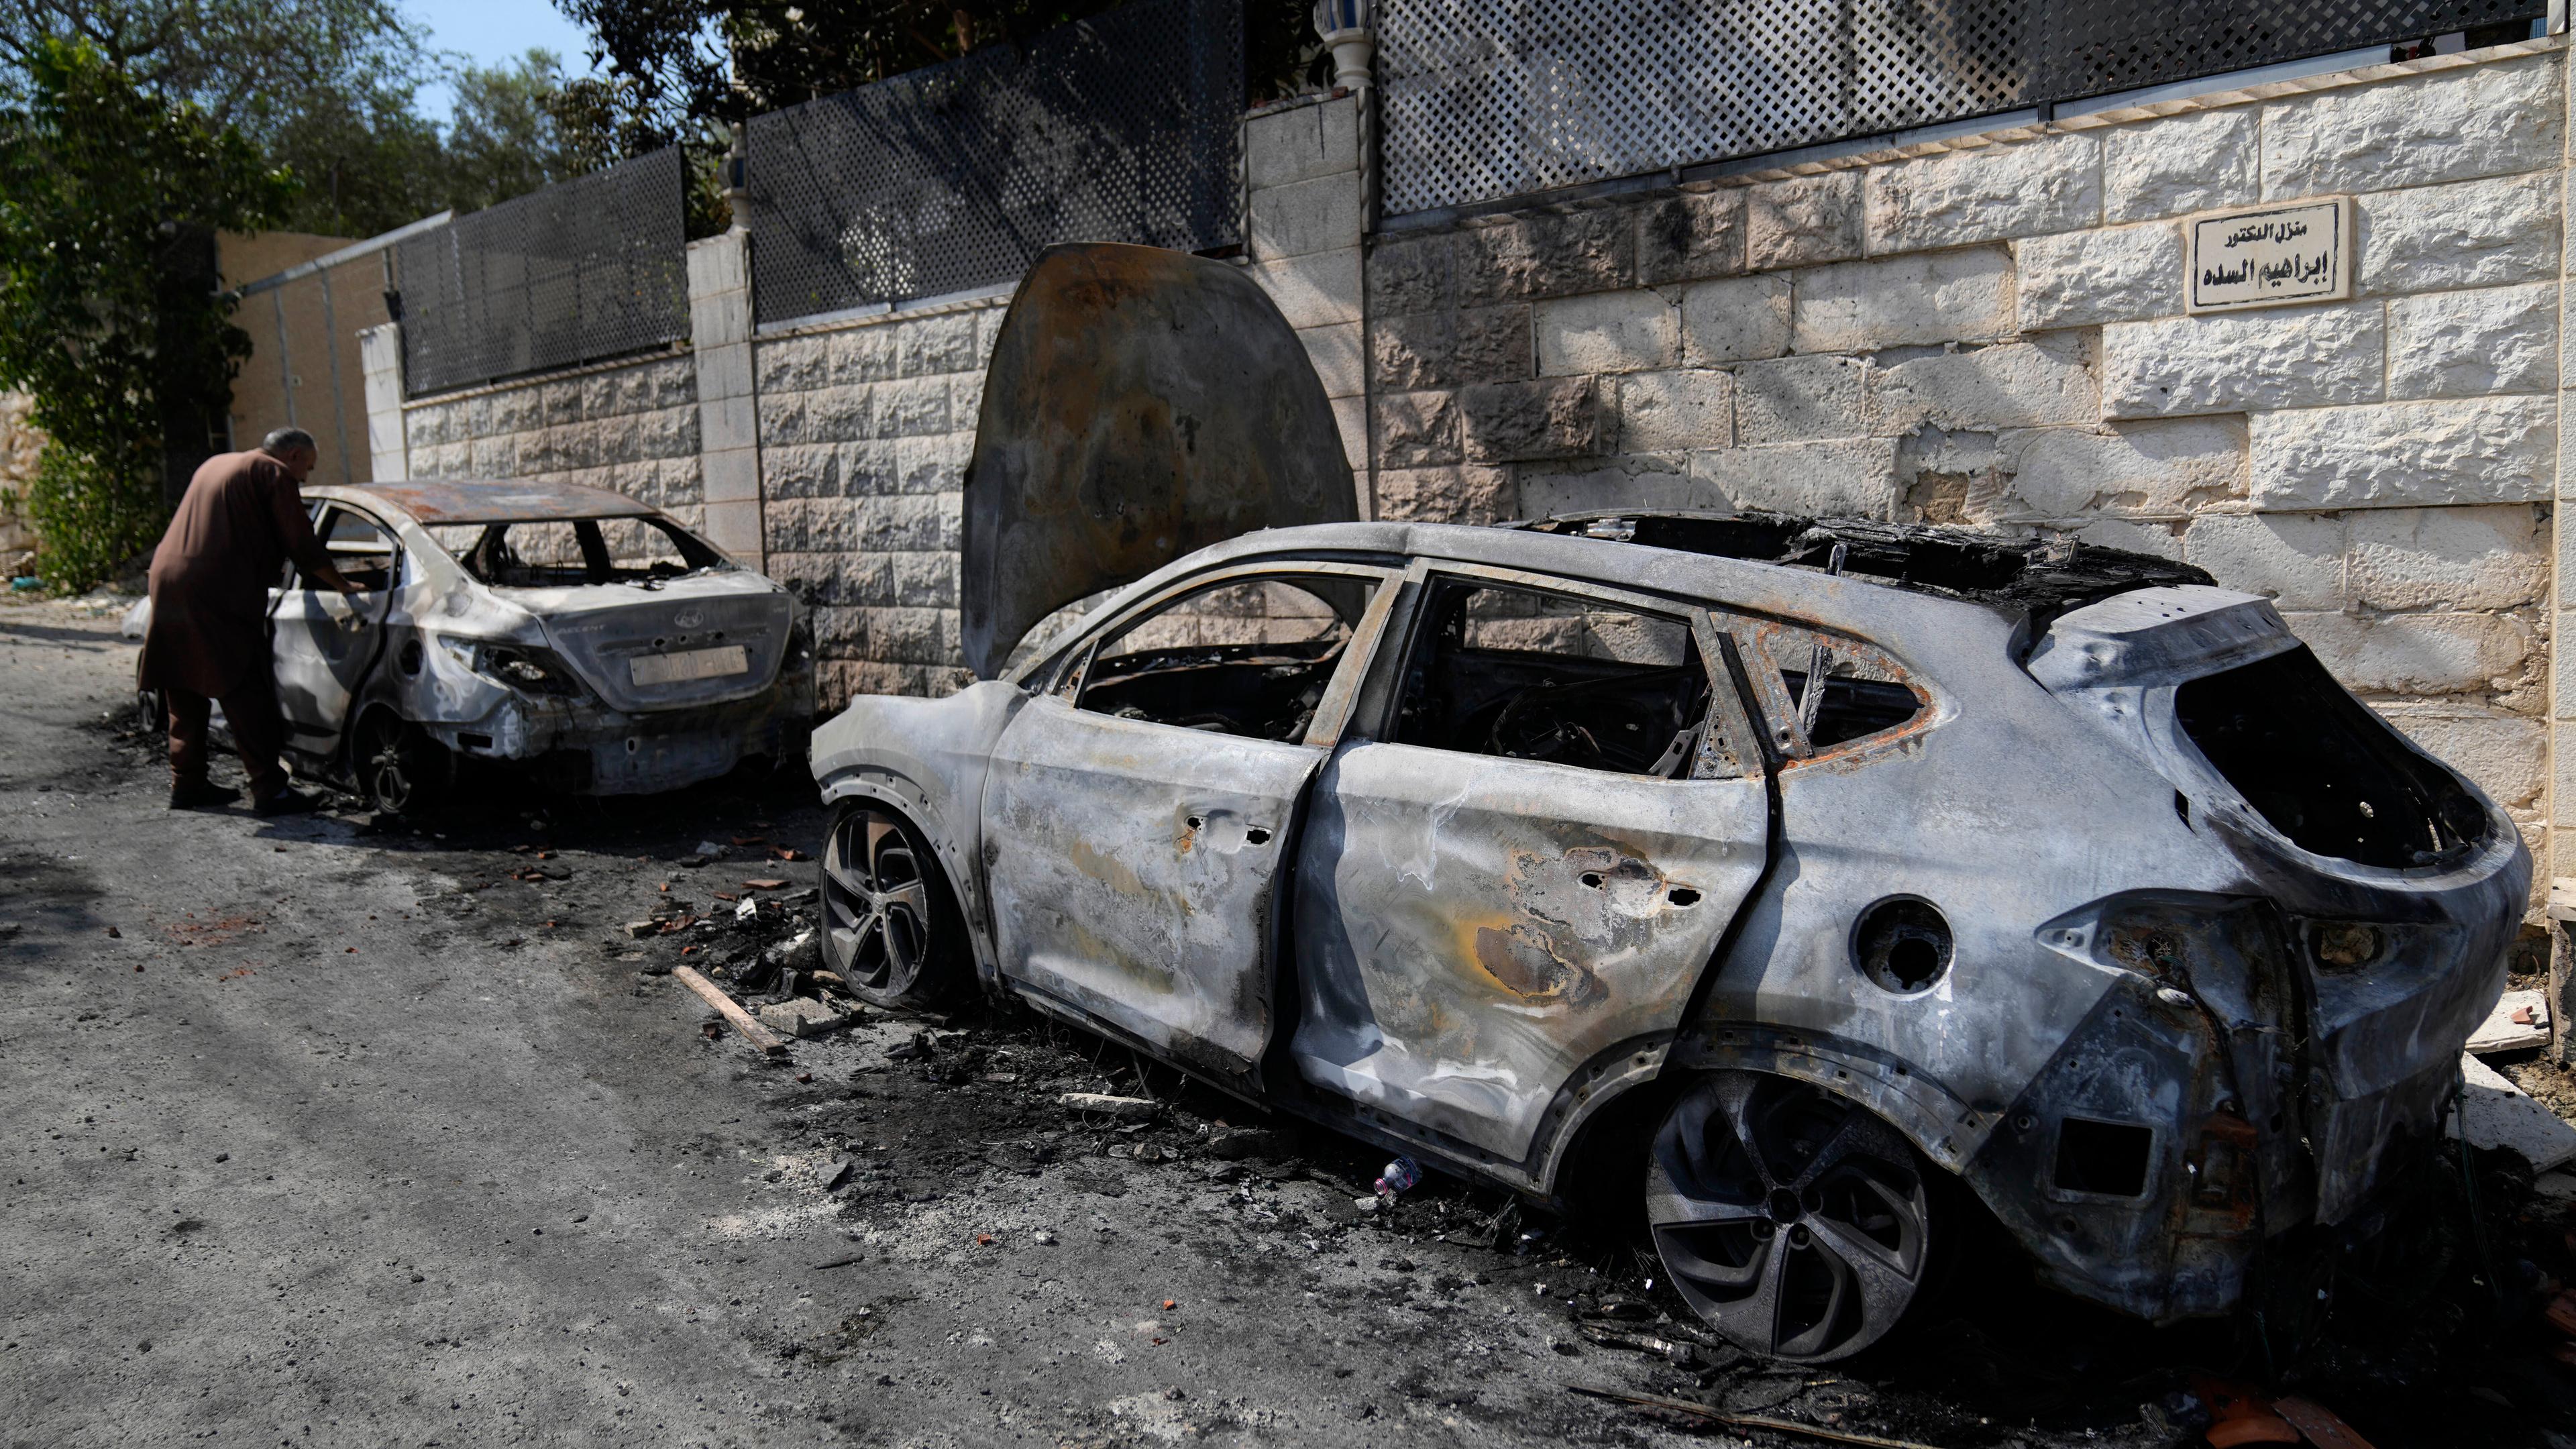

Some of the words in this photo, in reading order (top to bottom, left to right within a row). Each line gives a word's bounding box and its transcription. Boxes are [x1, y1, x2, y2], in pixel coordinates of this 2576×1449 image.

[2224, 223, 2274, 248] الدكتور
[2275, 221, 2307, 244] منزل
[2258, 250, 2328, 290] إبراهيم
